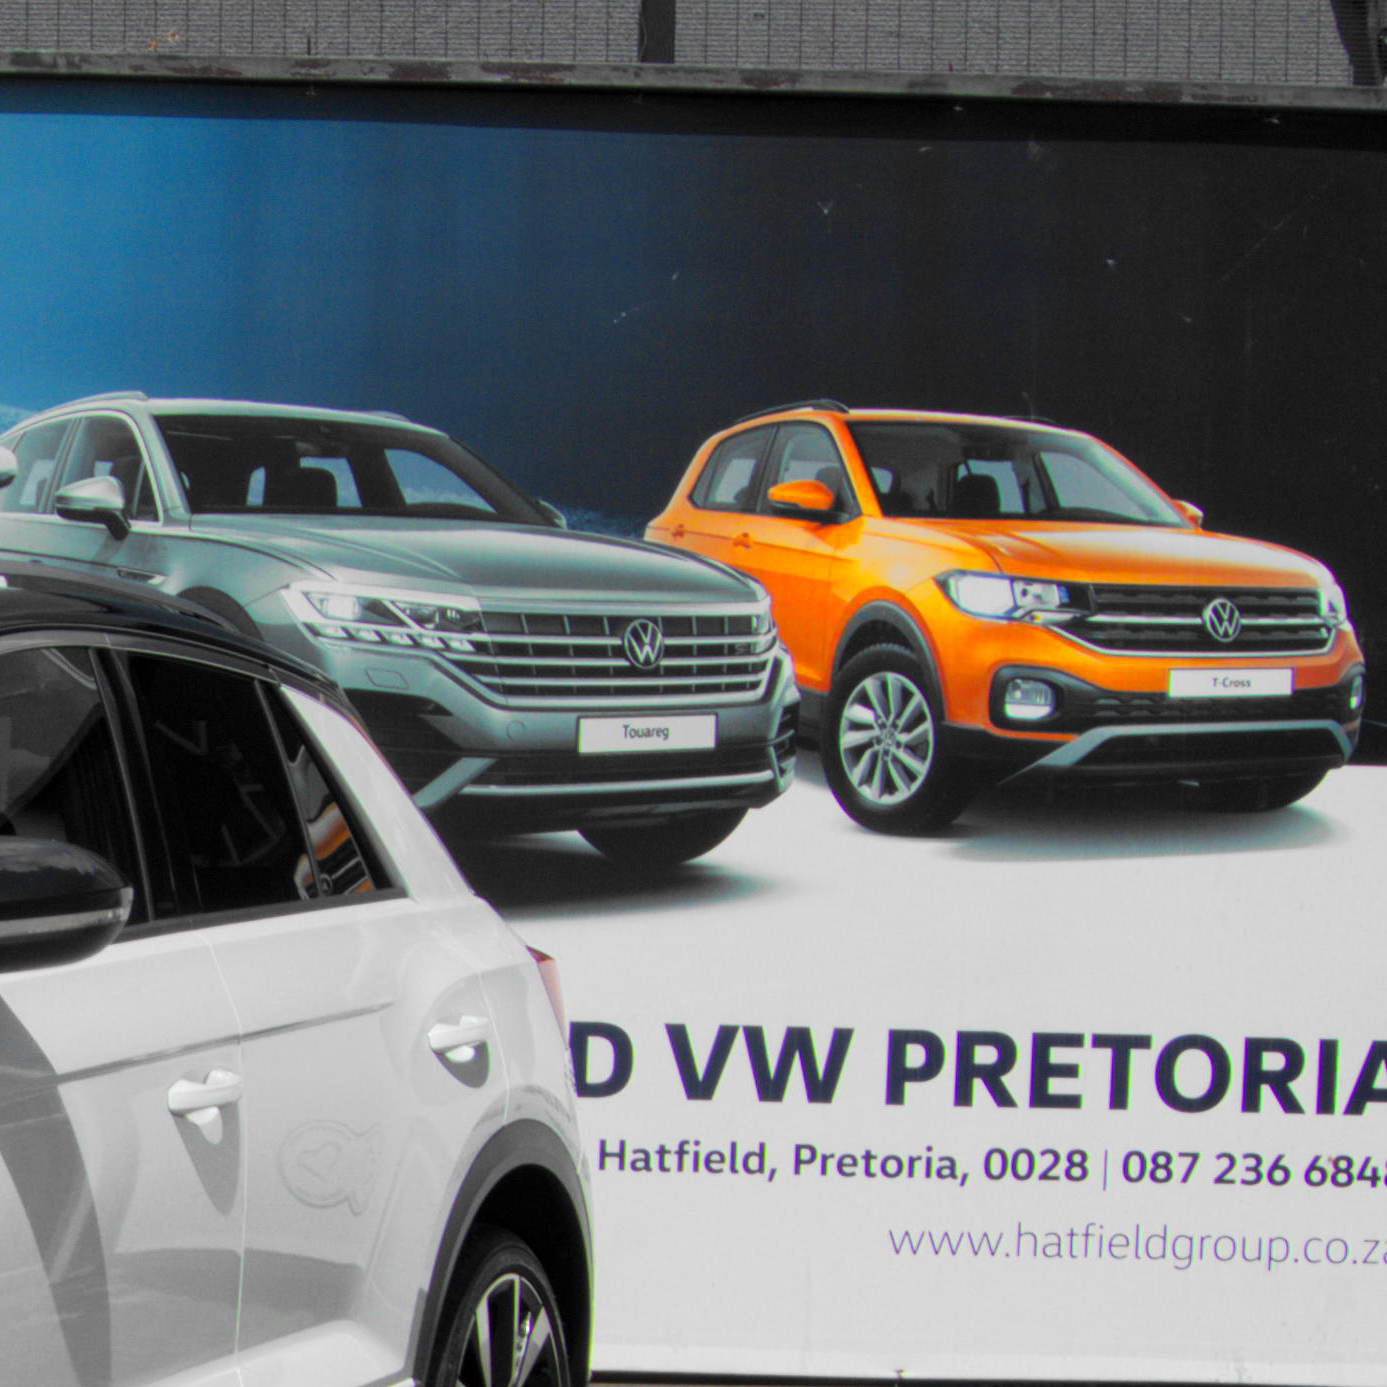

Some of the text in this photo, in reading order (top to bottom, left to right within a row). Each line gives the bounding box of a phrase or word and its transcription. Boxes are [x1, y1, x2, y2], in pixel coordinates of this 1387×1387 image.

[1212, 676, 1252, 688] T-Cross
[622, 724, 670, 740] Touareg
[664, 1022, 855, 1105] VW
[598, 1138, 1387, 1189] Hatfield, Pretoria, 0028 087 236 684
[888, 1221, 1387, 1273] www.hatfieldgroup.co.z
